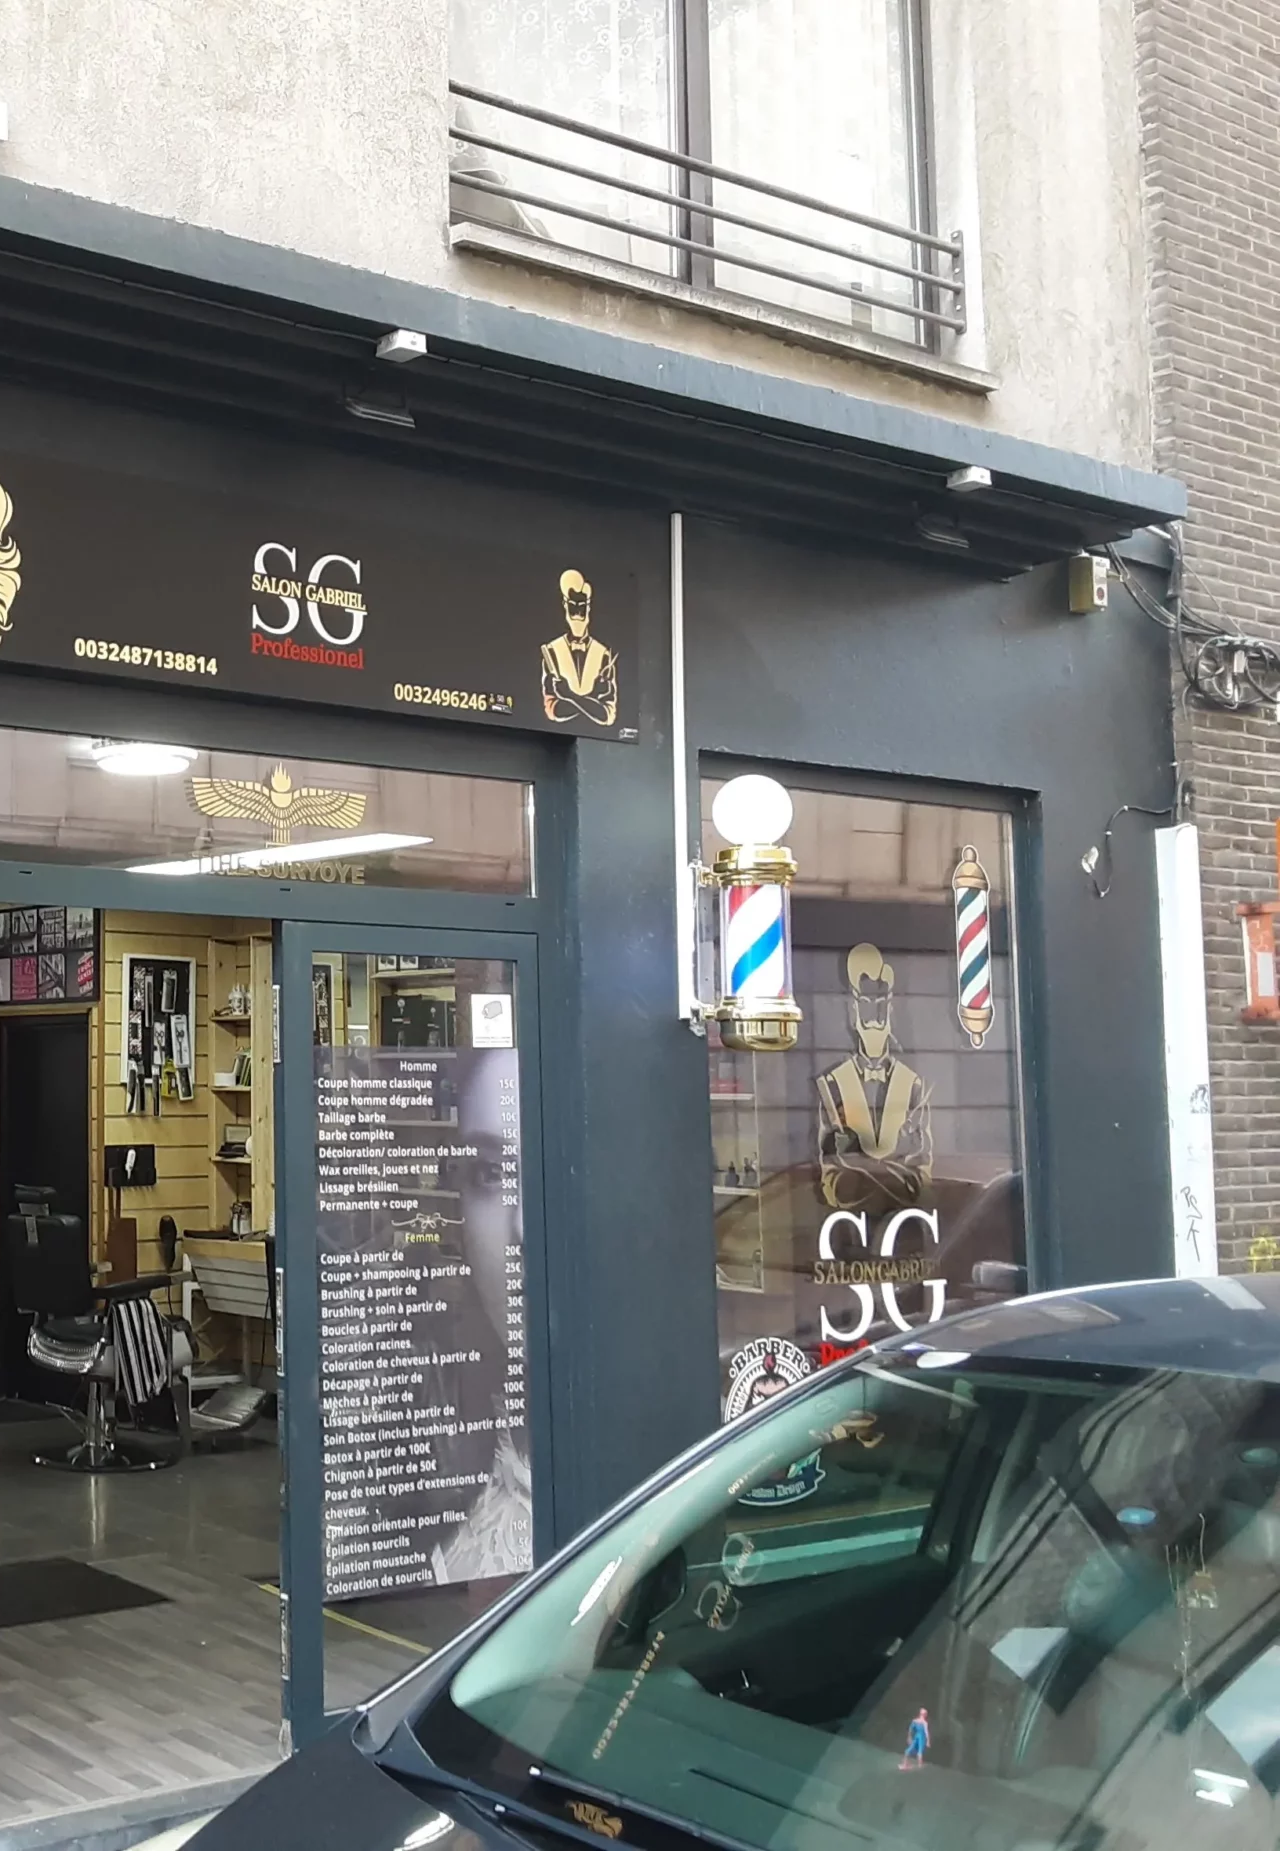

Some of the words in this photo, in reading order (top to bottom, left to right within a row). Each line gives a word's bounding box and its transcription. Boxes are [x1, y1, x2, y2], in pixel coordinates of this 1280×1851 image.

[252, 574, 301, 599] SALON
[306, 584, 366, 610] GABRIEL
[252, 542, 367, 645] SG
[74, 637, 218, 676] 0032487138814
[251, 632, 364, 669] Professionel
[257, 858, 366, 885] SURYOYE
[400, 1061, 437, 1072] Homme
[318, 1078, 348, 1089] Coupe
[351, 1079, 386, 1088] homme
[389, 1078, 432, 1090] classique
[499, 1080, 515, 1089] 15€
[318, 1095, 348, 1106] Coupe
[351, 1096, 387, 1106] homme
[500, 1096, 515, 1105] 20€
[318, 1113, 355, 1124] Taillage
[358, 1113, 386, 1123] barbe
[502, 1113, 516, 1122] 10€
[319, 1130, 347, 1140] Barbe
[350, 1129, 394, 1142] complète
[502, 1129, 517, 1138] 15€
[388, 1146, 435, 1156] coloration
[438, 1146, 448, 1156] de
[451, 1146, 477, 1156] barbe
[502, 1146, 517, 1155] 20€
[320, 1166, 340, 1176] Wax
[343, 1164, 380, 1176] oreilles,
[383, 1164, 408, 1177] joues
[411, 1164, 419, 1174] et
[422, 1165, 438, 1174] nez
[501, 1163, 516, 1172] 10€
[320, 1182, 355, 1194] Lissage
[357, 1181, 398, 1192] brésilien
[502, 1179, 517, 1188] 50€
[320, 1200, 379, 1211] Permanente
[390, 1200, 418, 1210] coupe
[502, 1196, 518, 1205] 50€
[405, 1232, 440, 1242] Femme
[321, 1253, 351, 1265] Coupe
[354, 1250, 360, 1262] à
[362, 1250, 389, 1264] partir
[392, 1250, 404, 1261] de
[505, 1245, 521, 1256] 20€
[321, 1271, 351, 1283] Coupe
[362, 1268, 420, 1281] shampooing
[423, 1264, 428, 1276] à
[431, 1265, 457, 1278] partir
[460, 1264, 470, 1275] de
[505, 1263, 521, 1273] 25€
[818, 1208, 948, 1342] SG
[322, 1288, 364, 1301] Brushing
[368, 1285, 373, 1298] à
[376, 1285, 402, 1299] partir
[406, 1284, 417, 1295] de
[506, 1280, 522, 1290] 20€
[322, 1306, 365, 1319] Brushing
[376, 1303, 396, 1315] soin
[398, 1301, 403, 1313] à
[406, 1300, 432, 1314] partir
[435, 1300, 447, 1311] de
[508, 1297, 523, 1307] 30€
[322, 1324, 359, 1336] Boucles
[362, 1322, 368, 1334] à
[371, 1321, 397, 1335] partir
[400, 1320, 412, 1331] de
[507, 1314, 522, 1323] 30€
[322, 1342, 373, 1354] Coloration
[376, 1340, 410, 1350] racines
[508, 1330, 523, 1340] 30€
[323, 1360, 374, 1372] Coloration
[377, 1358, 388, 1368] de
[390, 1354, 430, 1367] cheveux
[433, 1351, 438, 1363] à
[440, 1351, 466, 1364] partir
[469, 1350, 480, 1361] de
[508, 1348, 523, 1358] 50€
[732, 1337, 806, 1373] BARBER
[373, 1375, 379, 1387] à
[381, 1374, 408, 1388] partir
[411, 1373, 422, 1383] de
[508, 1365, 523, 1375] 50€
[364, 1394, 368, 1406] à
[402, 1391, 413, 1402] de
[504, 1382, 524, 1392] 100€
[324, 1413, 359, 1428] Lissage
[362, 1409, 403, 1423] brésilien
[406, 1407, 411, 1420] à
[414, 1407, 440, 1420] partir
[444, 1405, 454, 1416] de
[505, 1399, 524, 1409] 150€
[324, 1434, 345, 1447] Soin
[348, 1432, 376, 1444] Botox
[460, 1420, 465, 1432] à
[467, 1419, 493, 1433] partir
[496, 1417, 506, 1428] de
[509, 1416, 524, 1427] 50€
[324, 1451, 353, 1464] Botox
[356, 1449, 362, 1461] à
[364, 1447, 392, 1461] partir
[395, 1446, 406, 1457] de
[409, 1443, 430, 1455] 100€
[324, 1469, 365, 1483] Chignon
[368, 1466, 373, 1478] à
[376, 1464, 403, 1479] partir
[406, 1462, 417, 1474] de
[420, 1460, 436, 1472] 50€
[326, 1490, 348, 1501] Pose
[351, 1487, 362, 1498] de
[366, 1485, 386, 1496] tout
[389, 1482, 414, 1495] types
[417, 1475, 475, 1490] d'extensions
[478, 1473, 488, 1483] de
[419, 1515, 440, 1528] pour
[372, 1536, 410, 1550] sourcils
[373, 1553, 426, 1568] moustache
[327, 1580, 378, 1595] Coloration
[381, 1576, 393, 1586] de
[396, 1568, 432, 1583] sourcils
